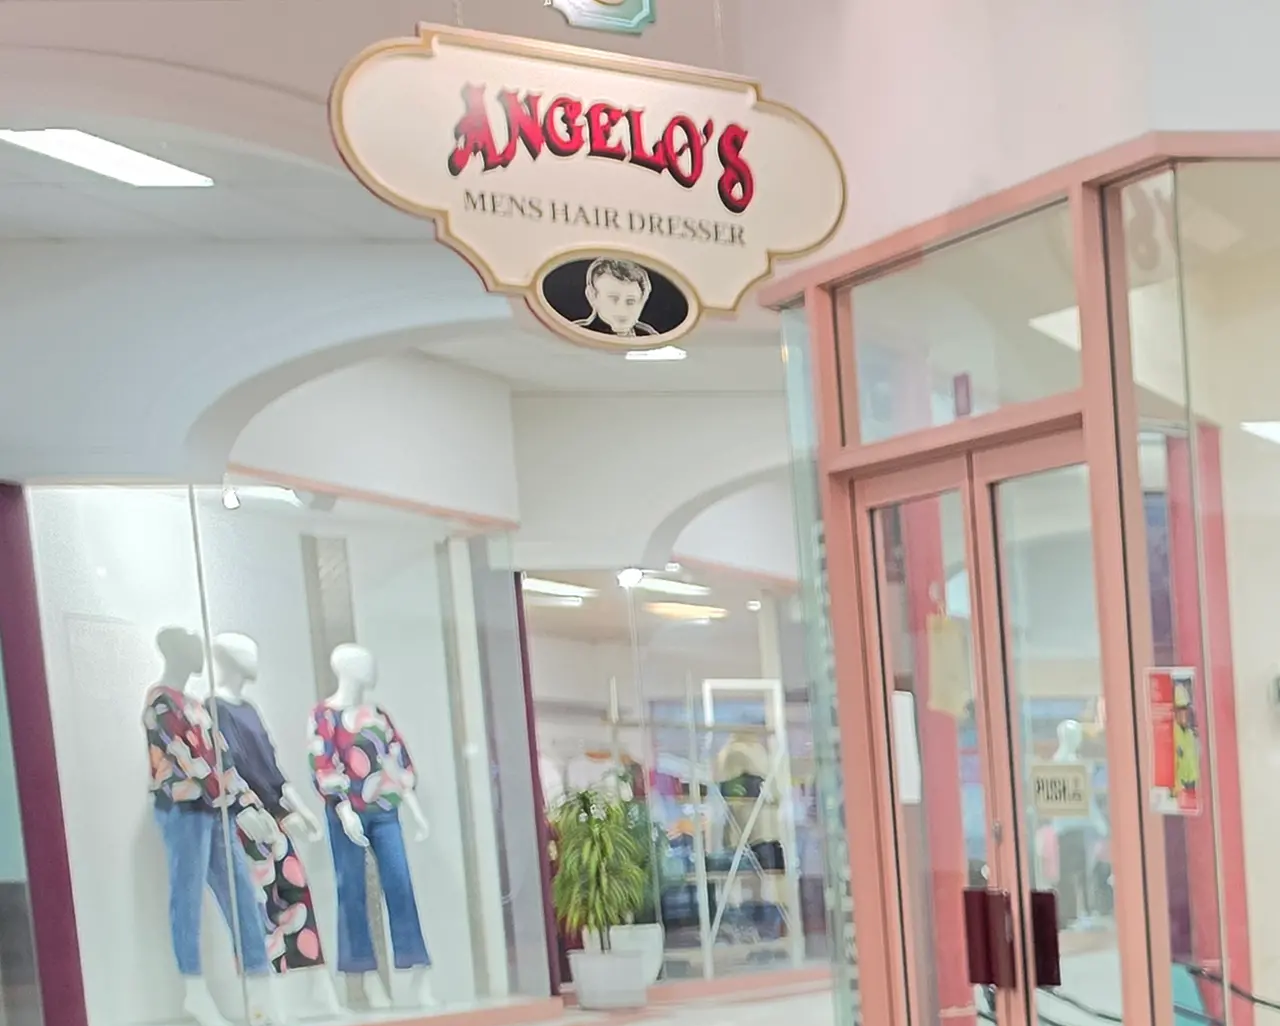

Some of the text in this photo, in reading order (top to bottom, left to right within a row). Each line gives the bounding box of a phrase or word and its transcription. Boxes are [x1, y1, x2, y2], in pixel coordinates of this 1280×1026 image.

[448, 82, 755, 214] ANGELO'S
[464, 188, 747, 246] MENS HAIR DRESSER
